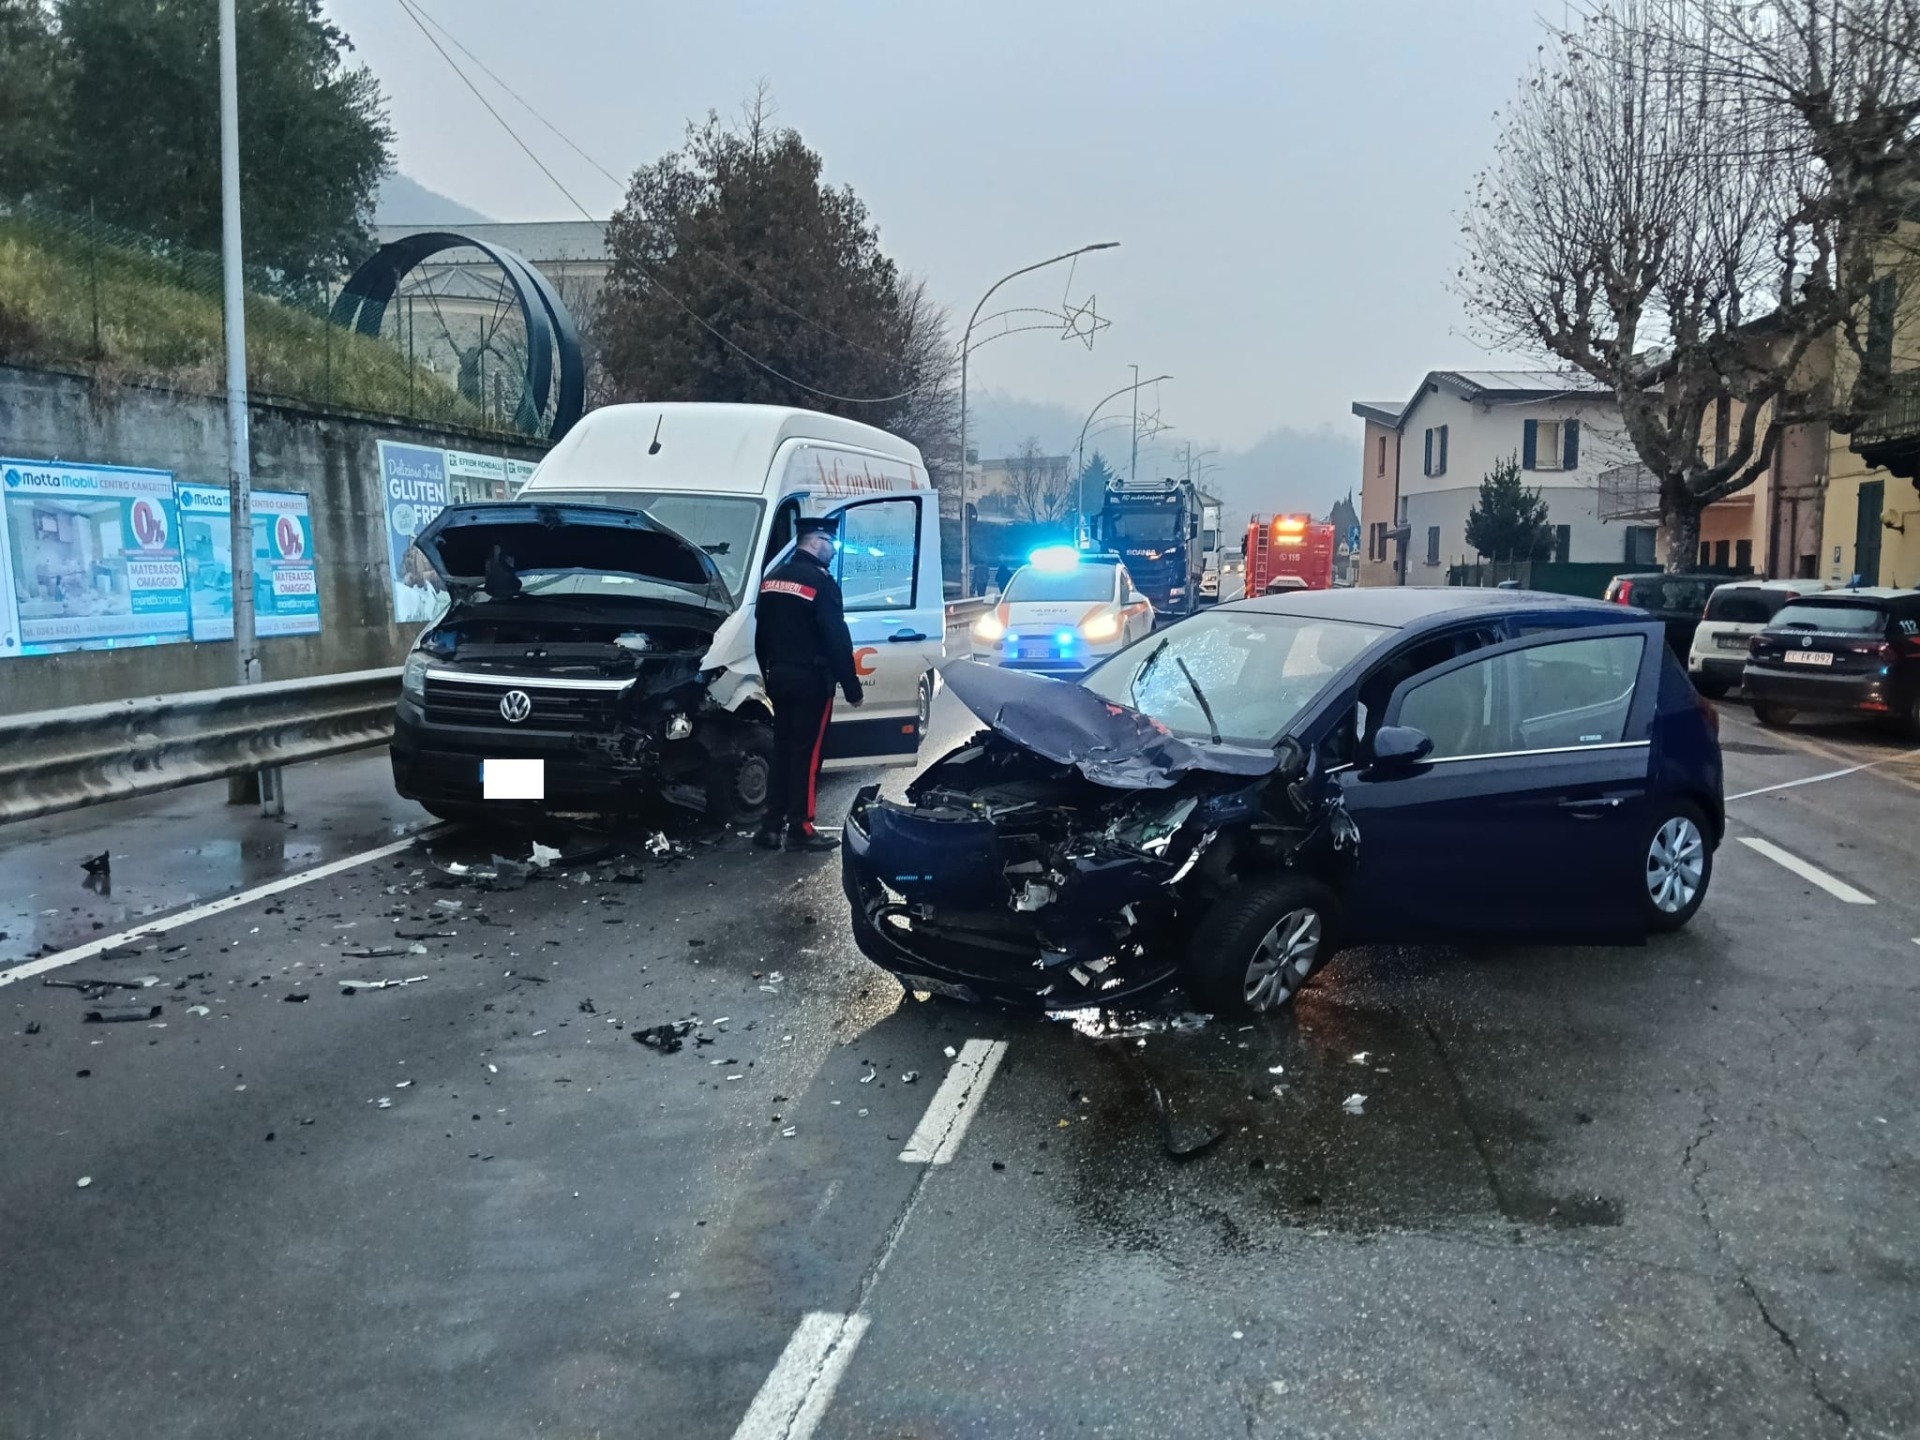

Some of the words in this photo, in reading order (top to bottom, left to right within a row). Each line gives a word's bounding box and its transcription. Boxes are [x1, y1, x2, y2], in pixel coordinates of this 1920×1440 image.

[22, 472, 60, 487] Motta
[389, 478, 445, 503] GLUTEN
[194, 493, 222, 506] Motta
[133, 501, 166, 545] 0%
[277, 518, 303, 556] 0%
[1288, 553, 1301, 562] 115
[130, 563, 180, 576] MATERASSO
[274, 571, 313, 581] MATERASSO
[136, 576, 178, 588] OMAGGIO
[280, 583, 311, 593] OMAGGIO
[1899, 619, 1917, 633] 112
